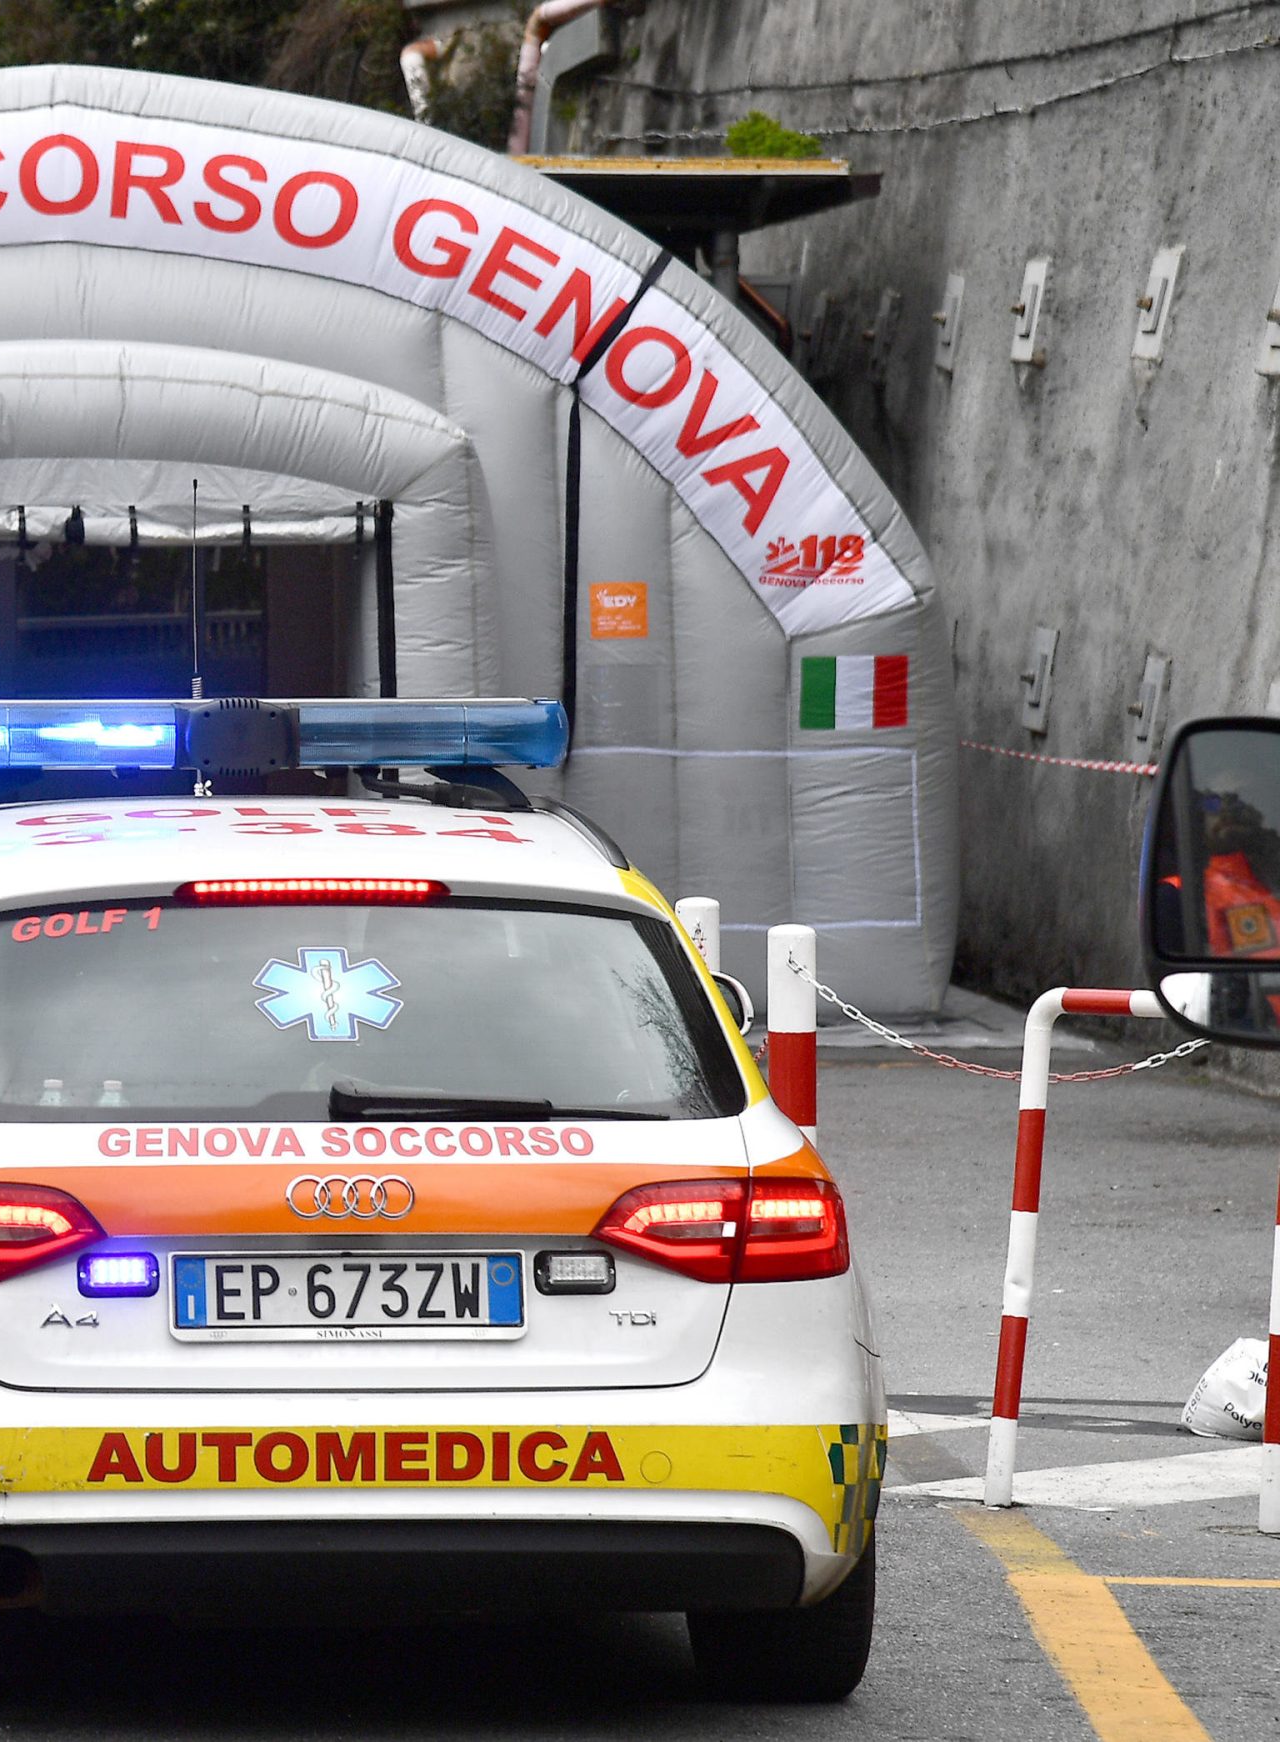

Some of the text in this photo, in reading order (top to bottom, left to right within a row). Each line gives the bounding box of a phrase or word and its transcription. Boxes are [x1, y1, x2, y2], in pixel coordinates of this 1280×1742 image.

[393, 197, 792, 537] GENOVA
[800, 534, 865, 570] 118
[758, 576, 807, 589] GENOVA
[16, 807, 391, 827] GOLF
[12, 905, 163, 943] GOLF 1
[99, 1126, 593, 1157] GENOVA SOCCORSO
[215, 1262, 481, 1320] EP 673ZW
[39, 1303, 100, 1329] A4
[316, 1330, 383, 1339] SIMONASSI
[87, 1430, 625, 1485] AUTOMEDICA
